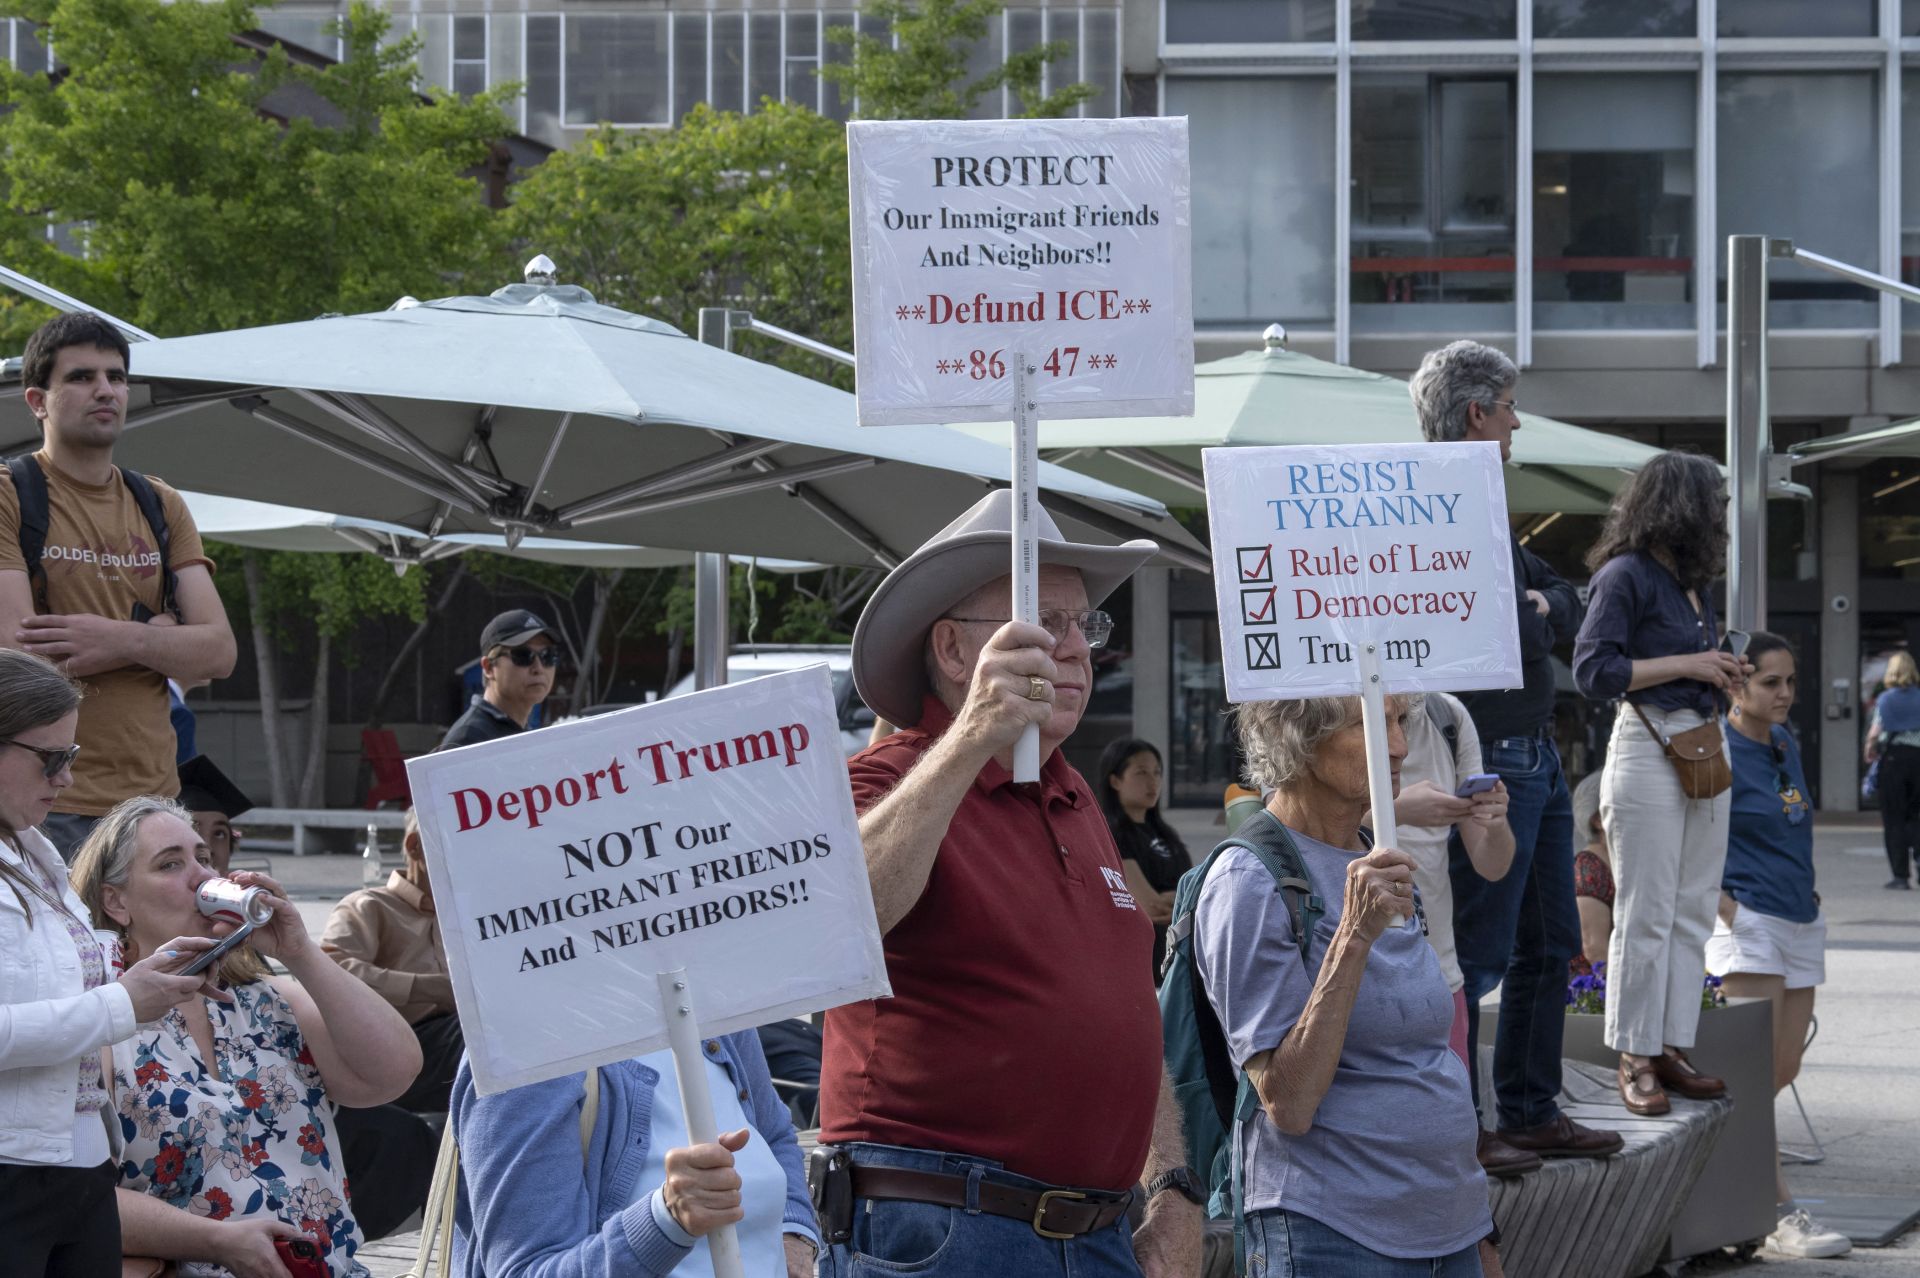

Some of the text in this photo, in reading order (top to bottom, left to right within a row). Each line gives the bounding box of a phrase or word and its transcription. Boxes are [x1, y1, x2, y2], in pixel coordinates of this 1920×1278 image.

[932, 155, 1113, 187] PROTECT
[884, 204, 1159, 234] Our Immigrant Friends
[920, 241, 1111, 271] And Neighbors!!
[1288, 461, 1419, 495] RESIST
[1267, 493, 1462, 530] TYRANNY
[1288, 544, 1472, 577] Rule of Law
[1292, 588, 1477, 622] Democracy
[448, 722, 810, 833] Deport Trump
[559, 820, 732, 879] NOT Our
[475, 833, 832, 941] IMMIGRANT FRIENDS
[518, 878, 809, 973] And NEIGHBORS!!
